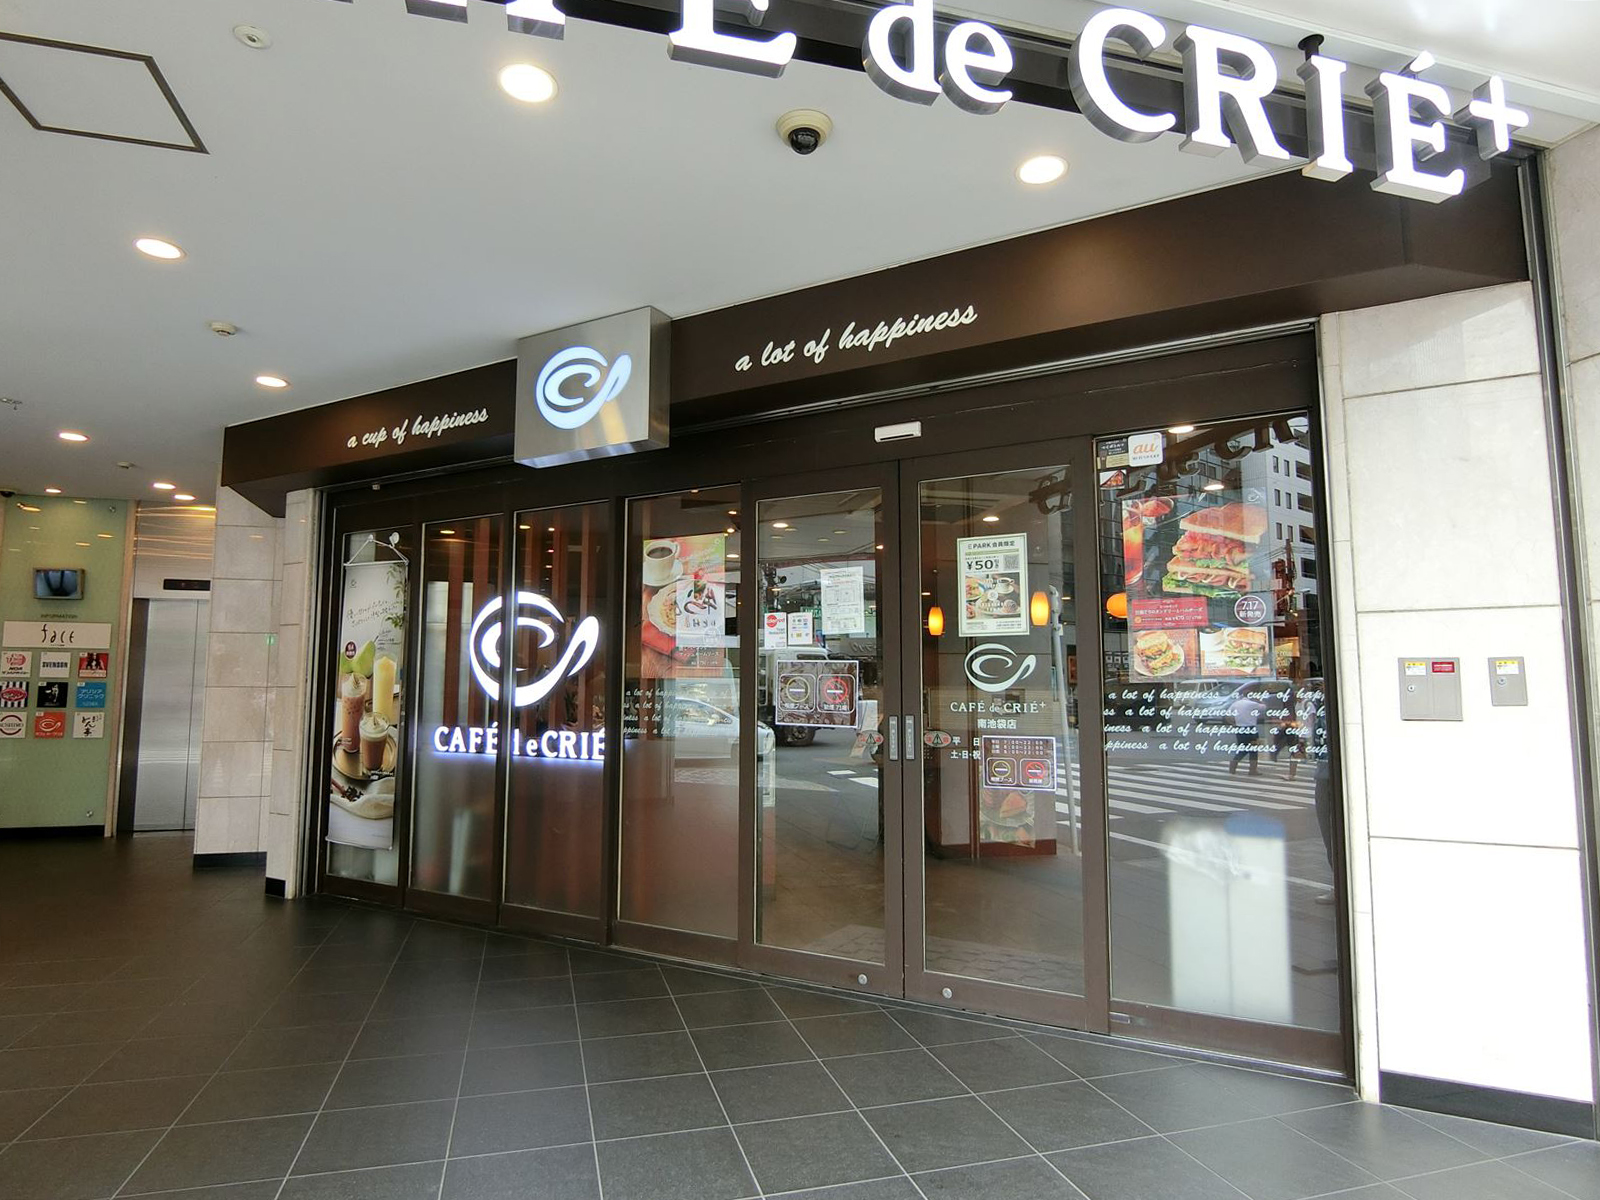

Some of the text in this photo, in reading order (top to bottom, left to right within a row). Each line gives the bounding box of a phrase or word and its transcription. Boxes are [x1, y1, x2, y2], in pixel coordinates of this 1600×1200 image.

[862, 0, 1012, 113] de
[735, 305, 978, 372] a lot of happiness
[347, 408, 489, 448] a cup of happiness
[41, 623, 75, 643] face
[1109, 691, 1117, 699] a
[1122, 689, 1138, 699] lot
[1143, 689, 1155, 702] of
[1160, 688, 1219, 701] happiness
[1247, 690, 1271, 701] cup
[1276, 688, 1292, 702] of
[950, 700, 986, 713] CAFÉ
[989, 702, 1001, 713] de
[1125, 708, 1134, 716] a
[1139, 705, 1156, 716] lot
[1160, 706, 1173, 719] of
[1178, 705, 1240, 719] happiness
[1266, 707, 1291, 719] cup
[1296, 706, 1311, 720] of
[977, 718, 1018, 730] 南池袋店
[1141, 725, 1150, 733] a
[1156, 722, 1173, 733] lot
[1177, 723, 1190, 736] of
[1195, 722, 1258, 736] happiness
[1269, 727, 1279, 735] a
[1285, 725, 1310, 737] cup
[434, 721, 499, 754] CAFÉ
[1159, 742, 1168, 750] a
[1173, 740, 1190, 750] lot
[1195, 740, 1208, 754] of
[1213, 740, 1277, 754] happiness
[1288, 743, 1299, 753] a
[1305, 743, 1328, 756] cup
